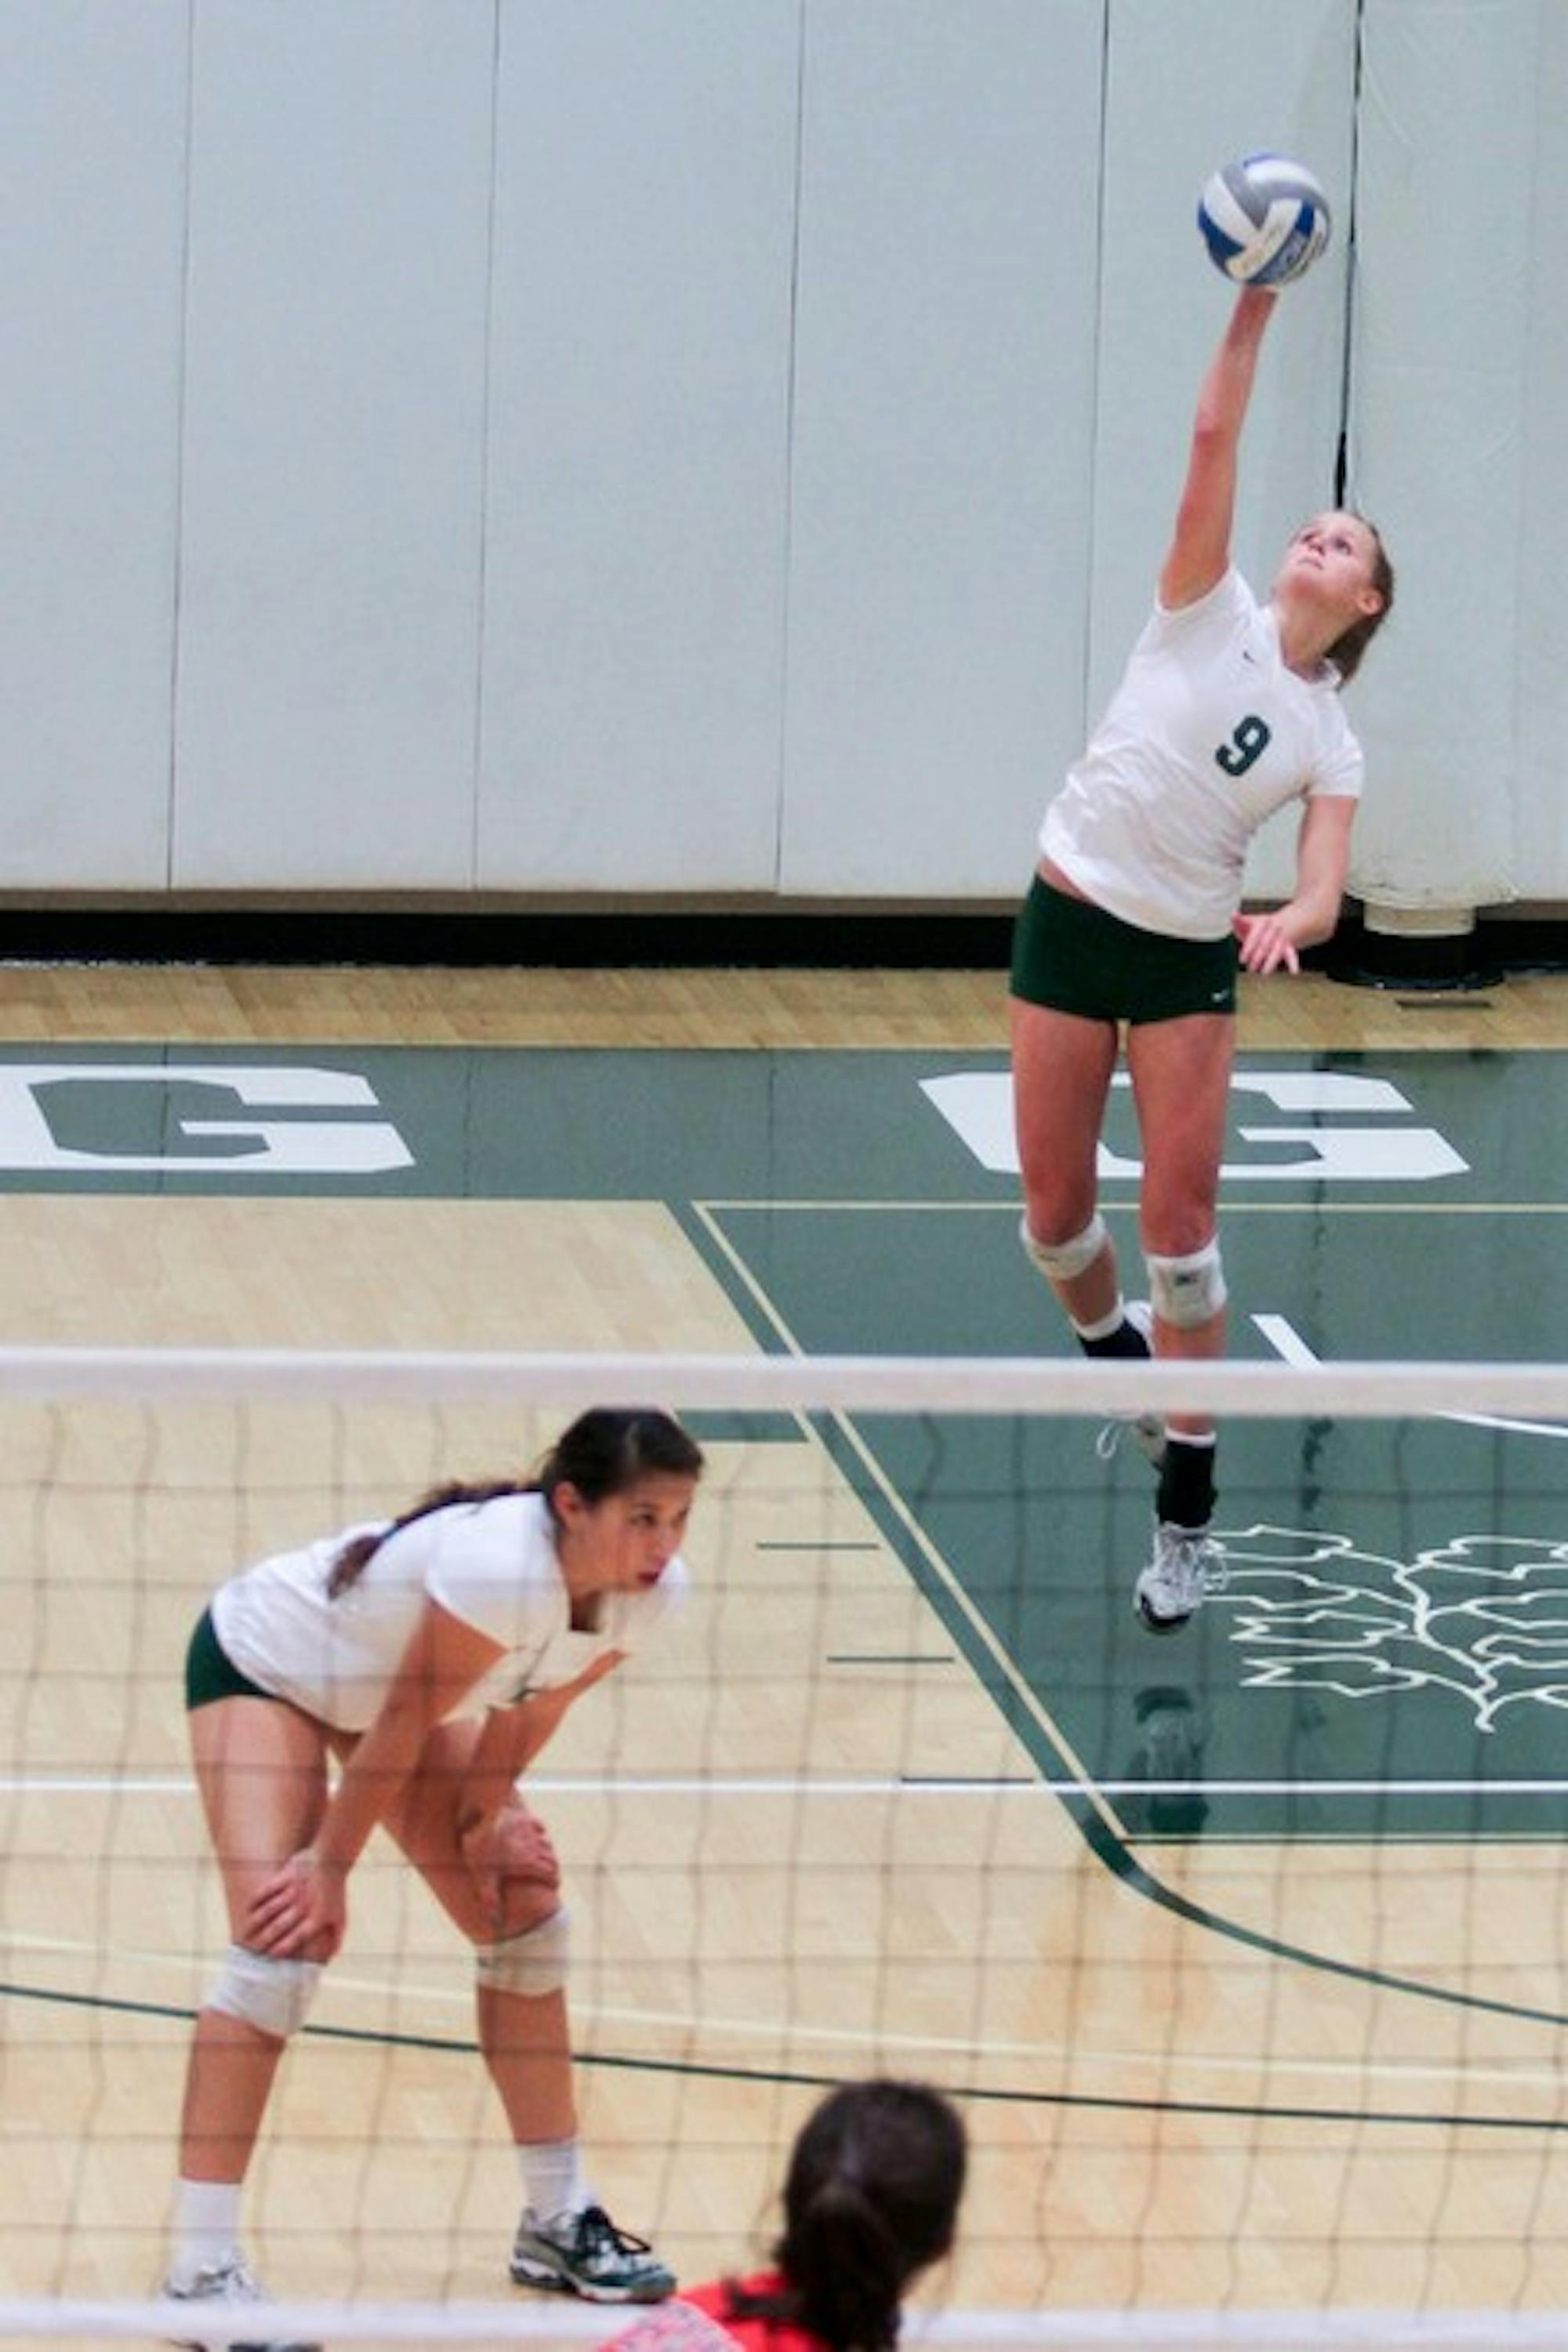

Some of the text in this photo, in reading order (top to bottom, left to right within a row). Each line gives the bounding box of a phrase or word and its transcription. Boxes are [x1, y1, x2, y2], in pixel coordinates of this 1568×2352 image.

[1215, 716, 1272, 776] 9
[0, 1064, 1471, 1180] G G
